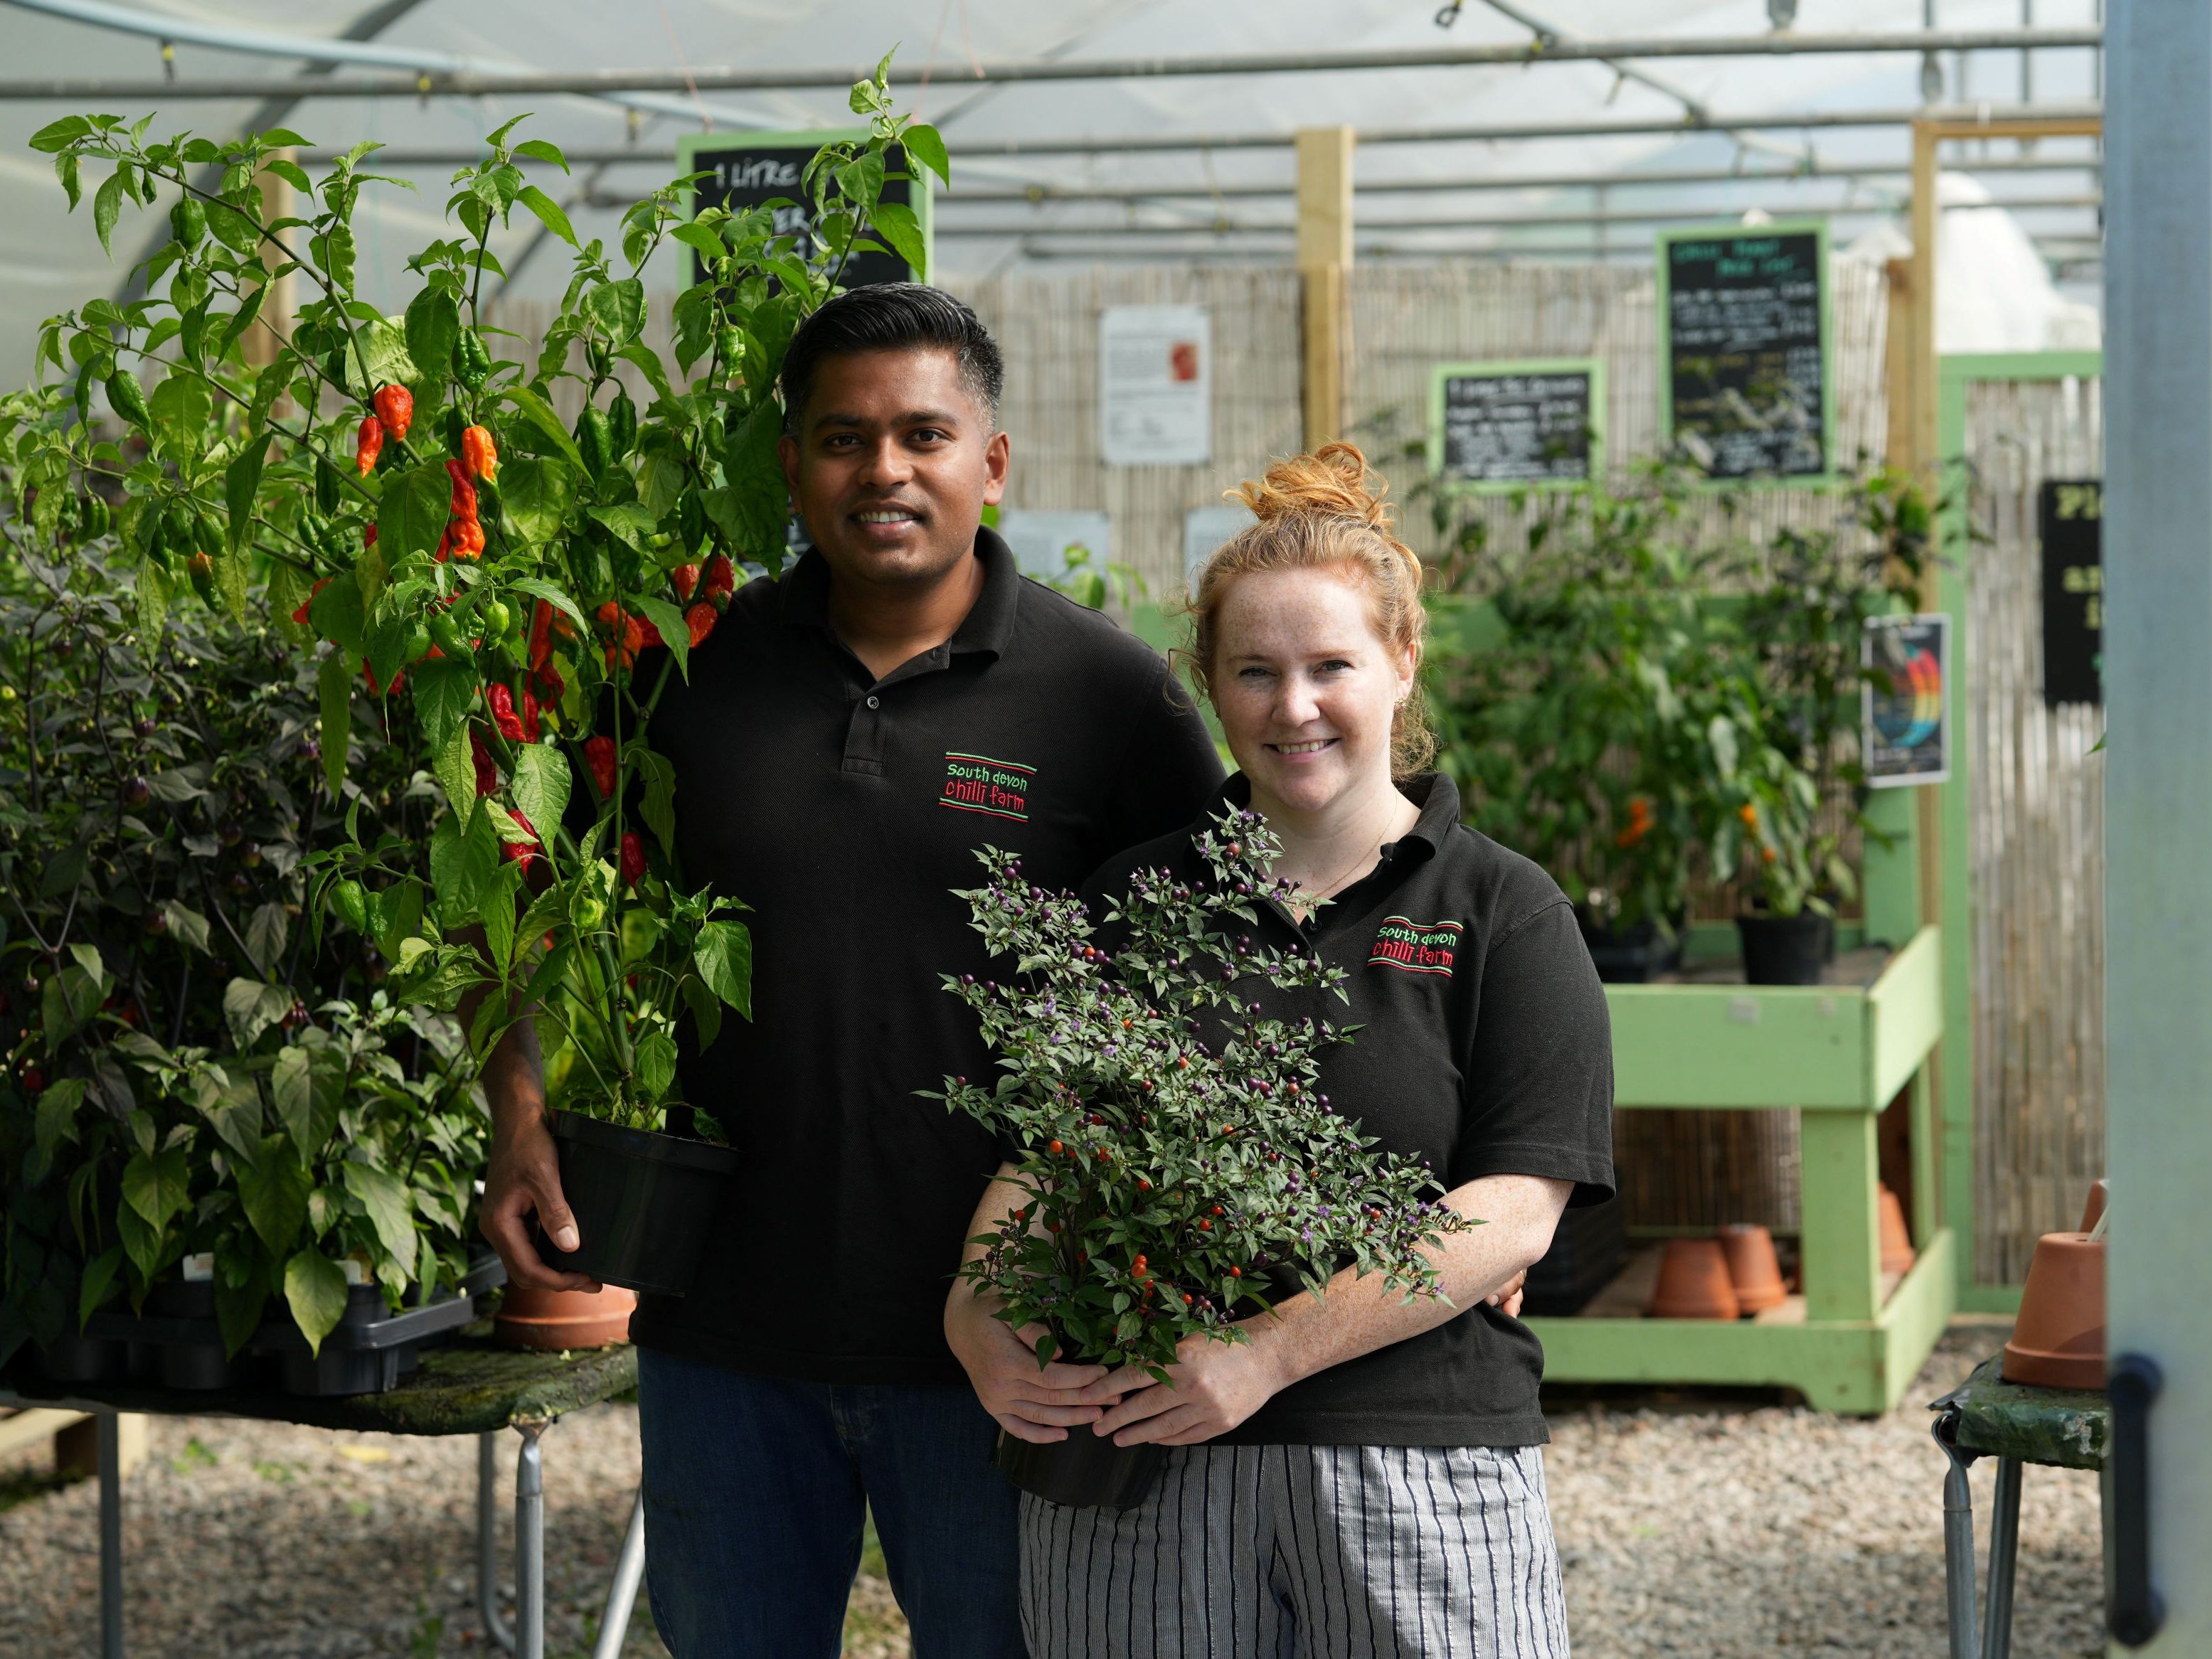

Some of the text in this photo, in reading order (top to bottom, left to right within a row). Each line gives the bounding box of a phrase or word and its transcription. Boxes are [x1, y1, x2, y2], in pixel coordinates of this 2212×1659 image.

[993, 772, 1027, 791] devon
[945, 779, 1025, 811] chilli farm
[1421, 933, 1457, 946] devon
[1373, 938, 1453, 967] chilli farm
